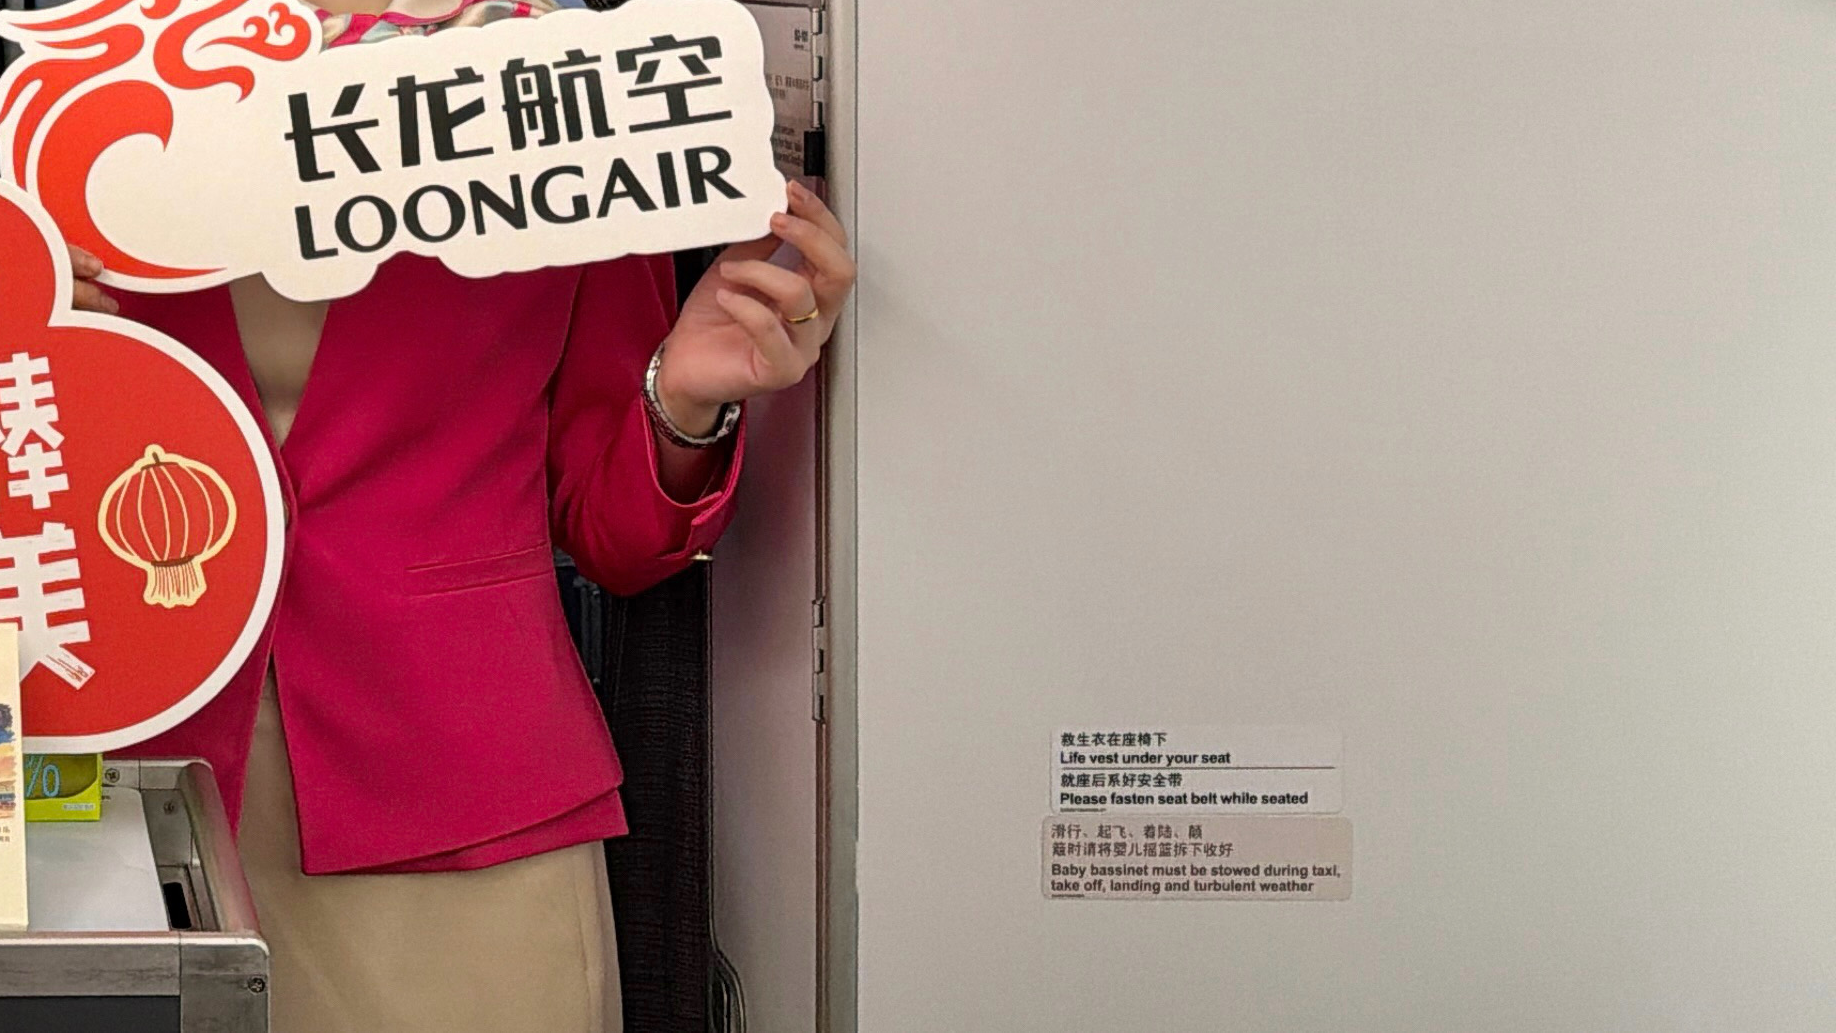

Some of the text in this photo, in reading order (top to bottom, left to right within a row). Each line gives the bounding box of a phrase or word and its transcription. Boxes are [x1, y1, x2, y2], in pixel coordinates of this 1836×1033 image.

[284, 34, 733, 182] 长龙航空
[295, 146, 747, 260] LOONGAIR
[1060, 732, 1167, 747] 救生衣在座椅下
[1060, 751, 1231, 767] Life vest under your seat
[1061, 772, 1182, 788] 就座后系好安全带
[1060, 791, 1308, 805] Please fasten seat belt while seated
[1051, 864, 1341, 879] Baby bassinet must be stowed during taxi,
[1051, 879, 1314, 894] take off, landing and turbulent weather
